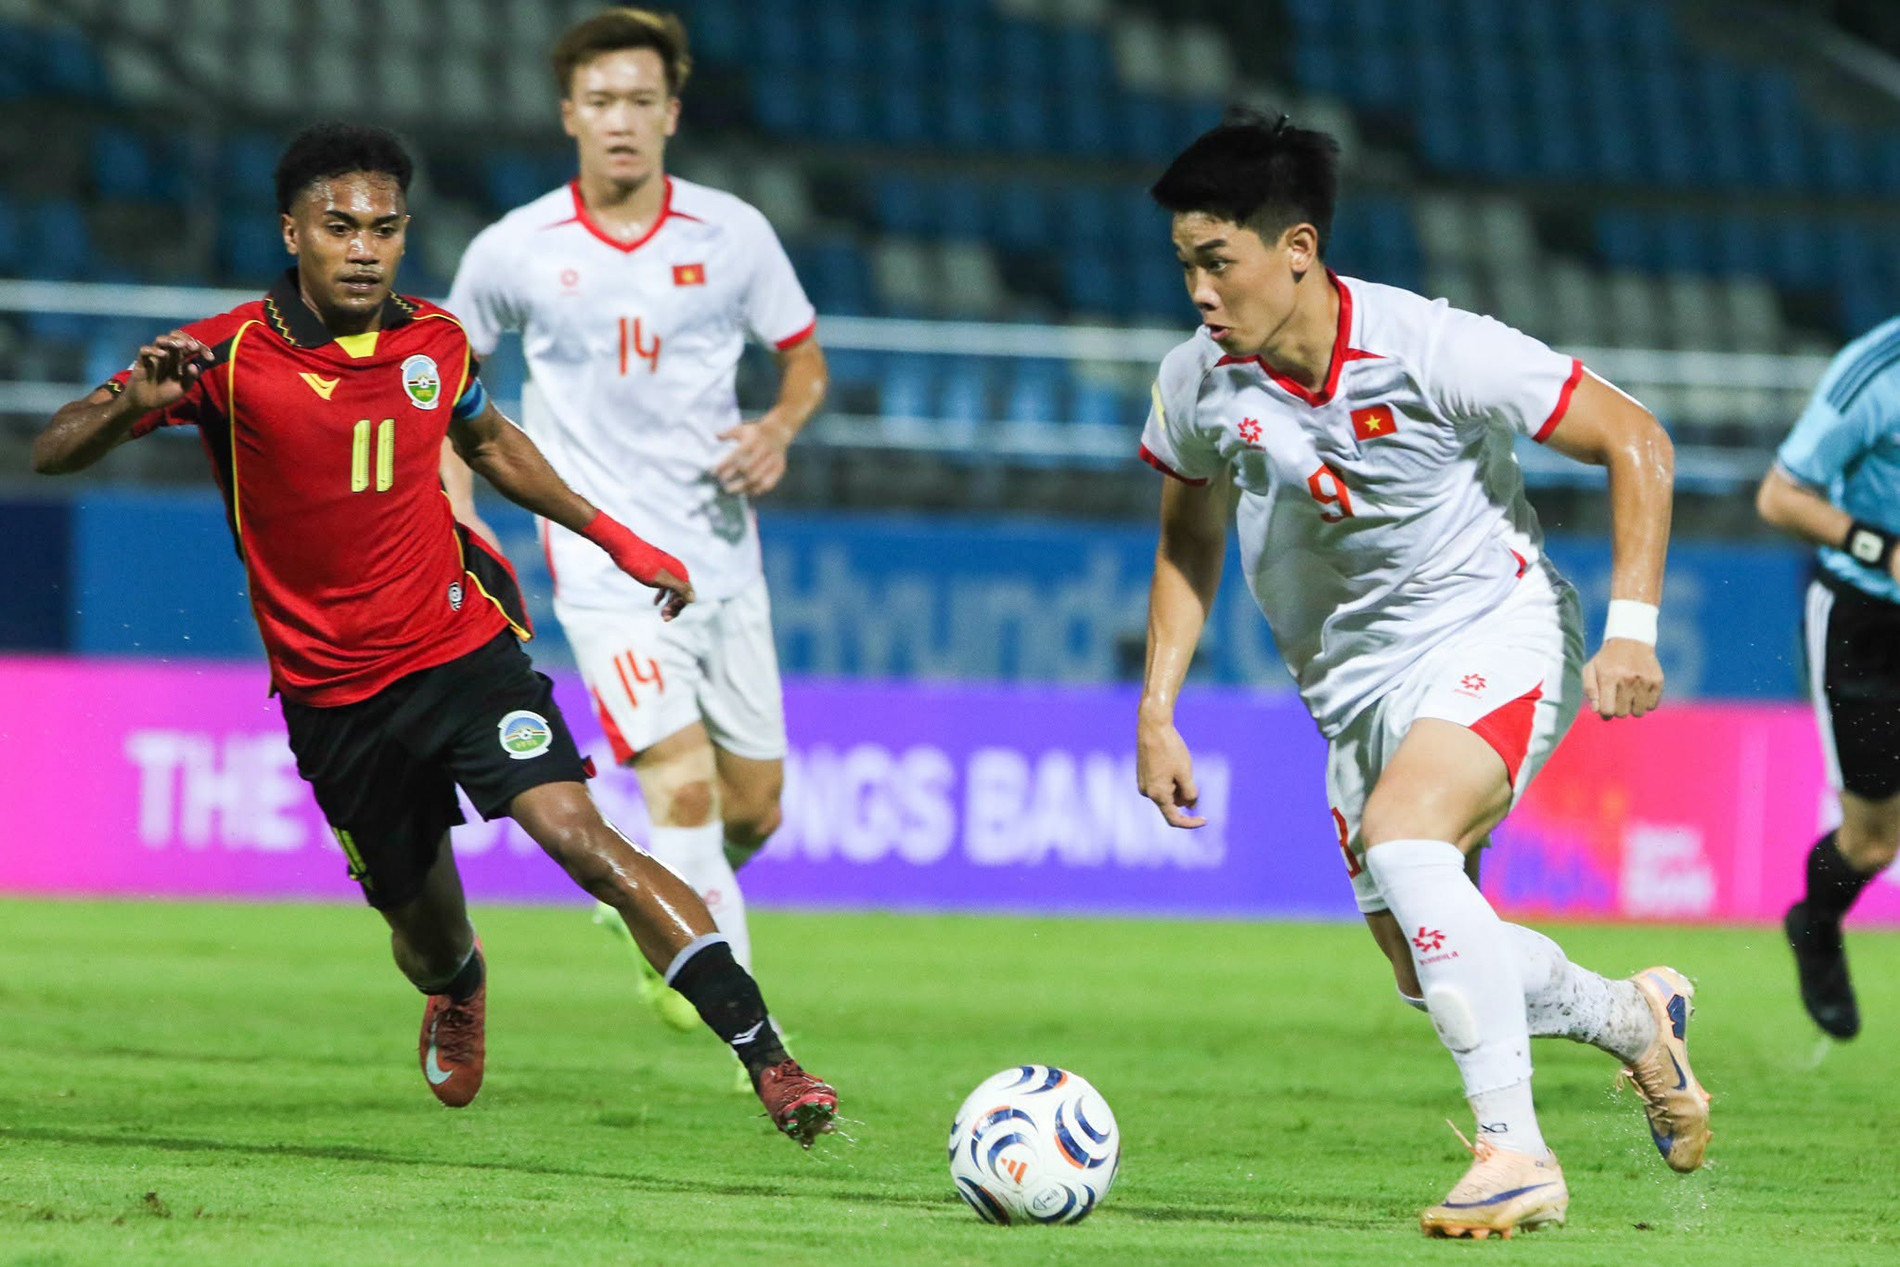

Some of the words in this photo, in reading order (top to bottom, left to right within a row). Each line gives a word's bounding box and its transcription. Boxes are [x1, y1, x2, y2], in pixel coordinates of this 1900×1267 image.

[618, 316, 661, 376] 14
[351, 418, 395, 492] 11
[1307, 464, 1354, 523] 9
[614, 650, 664, 709] 14
[126, 730, 306, 850] THE
